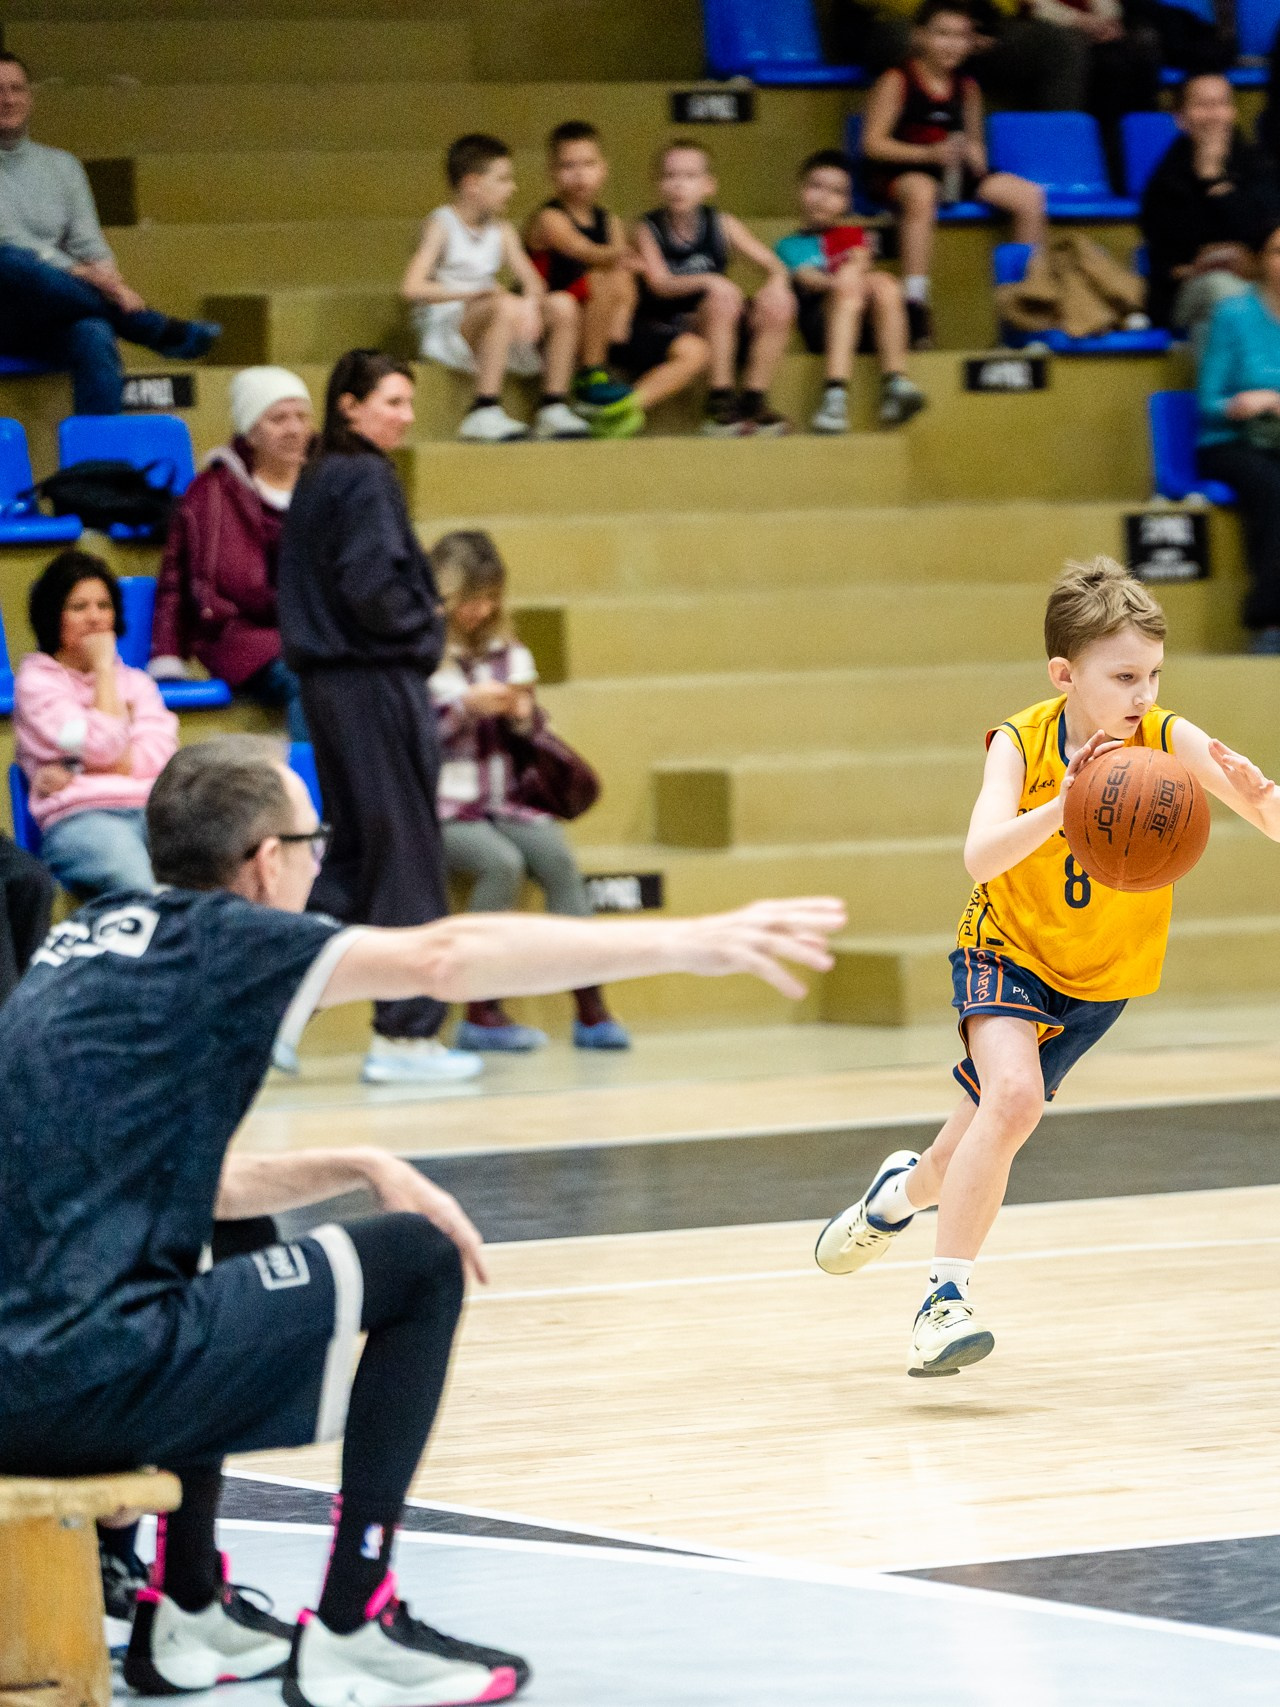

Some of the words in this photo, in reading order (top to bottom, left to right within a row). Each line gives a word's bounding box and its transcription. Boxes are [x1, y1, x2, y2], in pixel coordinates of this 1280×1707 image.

[1094, 759, 1131, 845] JÖGEL
[1150, 779, 1175, 838] JB-100
[1065, 853, 1092, 909] 8
